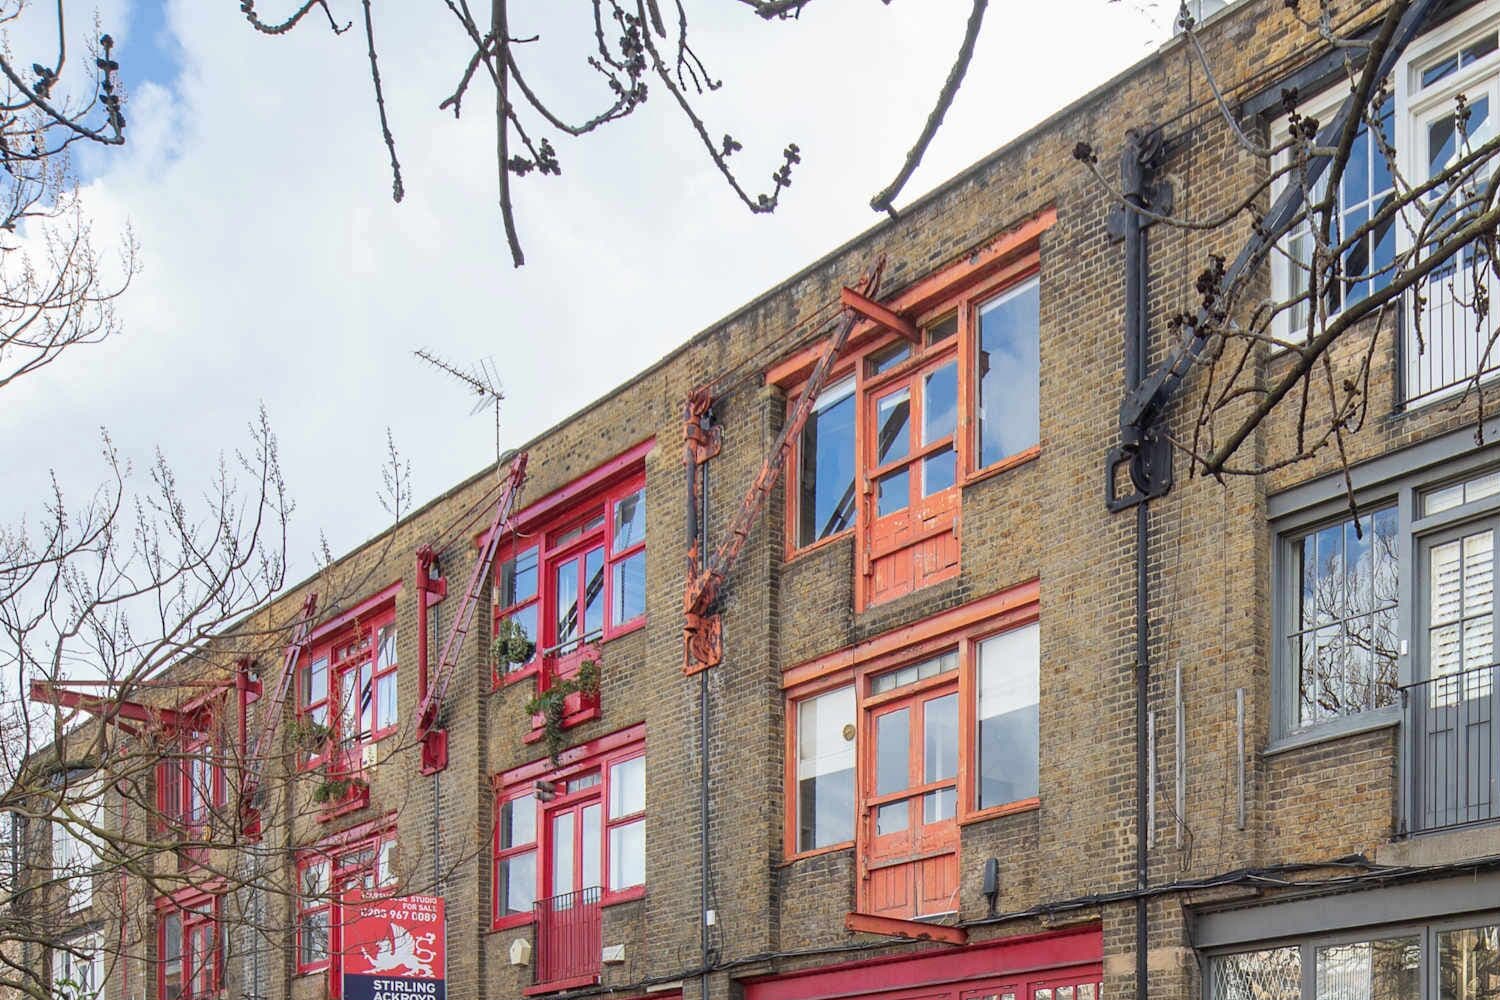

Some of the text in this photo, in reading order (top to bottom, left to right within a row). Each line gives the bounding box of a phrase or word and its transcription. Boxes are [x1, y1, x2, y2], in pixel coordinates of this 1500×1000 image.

[410, 895, 437, 904] STUDIO
[390, 910, 409, 919] 967
[411, 911, 437, 922] 0089
[373, 980, 436, 993] STIRLING
